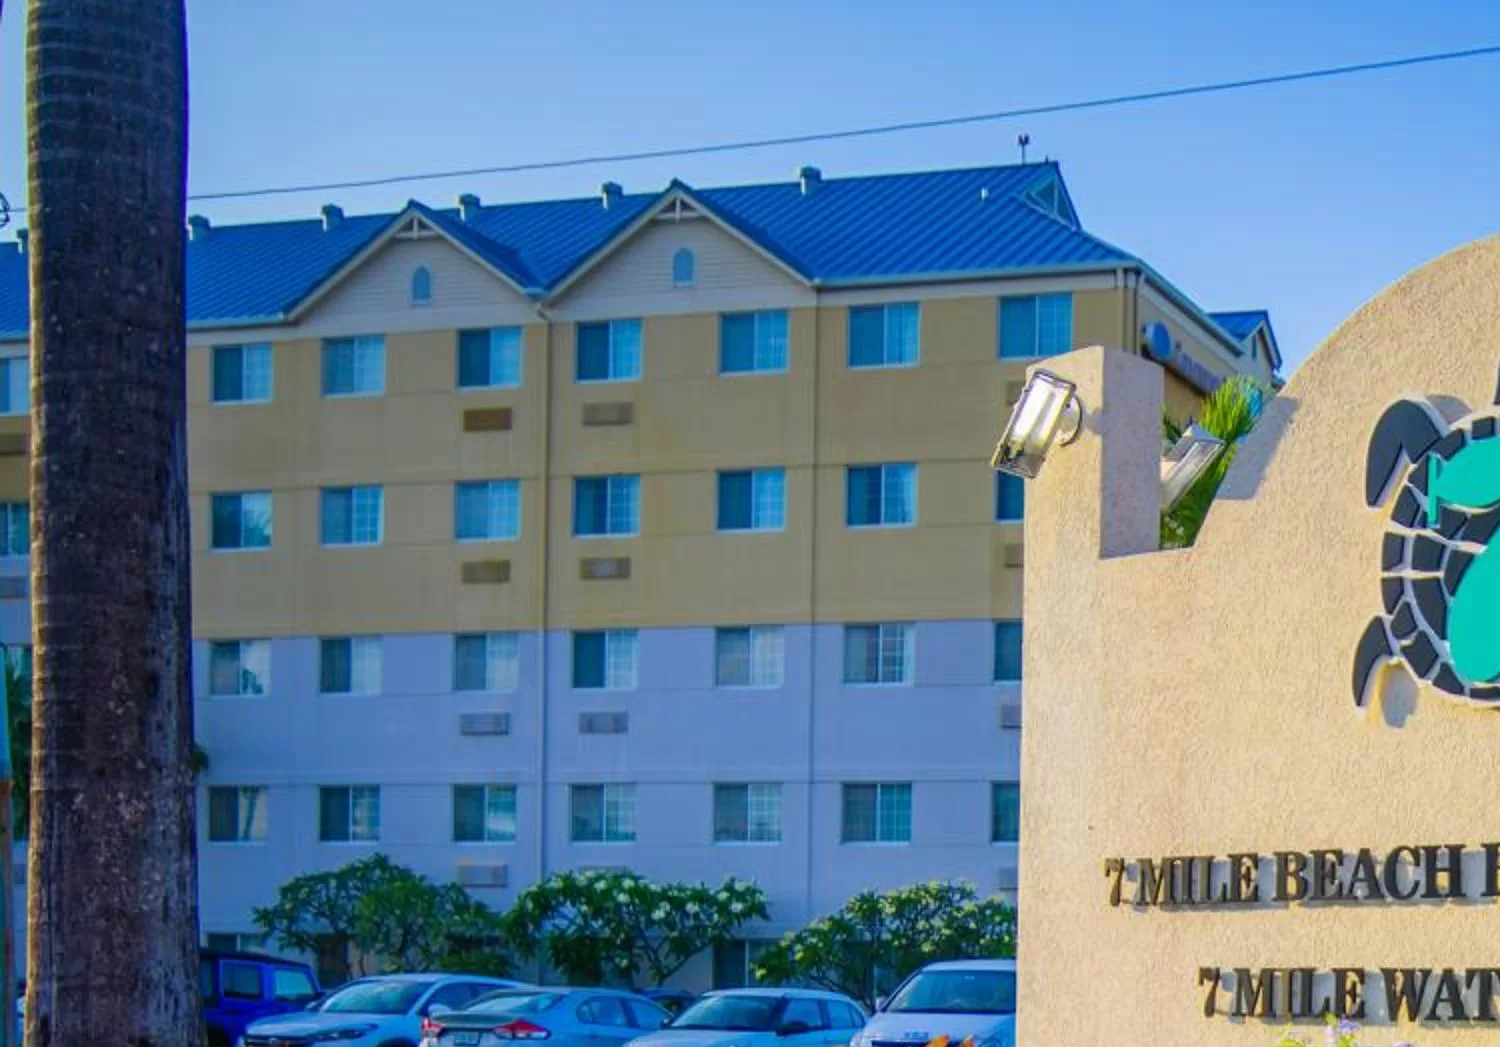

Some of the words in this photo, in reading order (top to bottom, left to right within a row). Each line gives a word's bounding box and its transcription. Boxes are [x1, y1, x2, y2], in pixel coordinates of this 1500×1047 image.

[1105, 857, 1125, 906] 7
[1135, 853, 1259, 906] MILE
[1273, 844, 1466, 901] BEACH
[1199, 966, 1221, 1018] 7
[1231, 967, 1365, 1017] MILE
